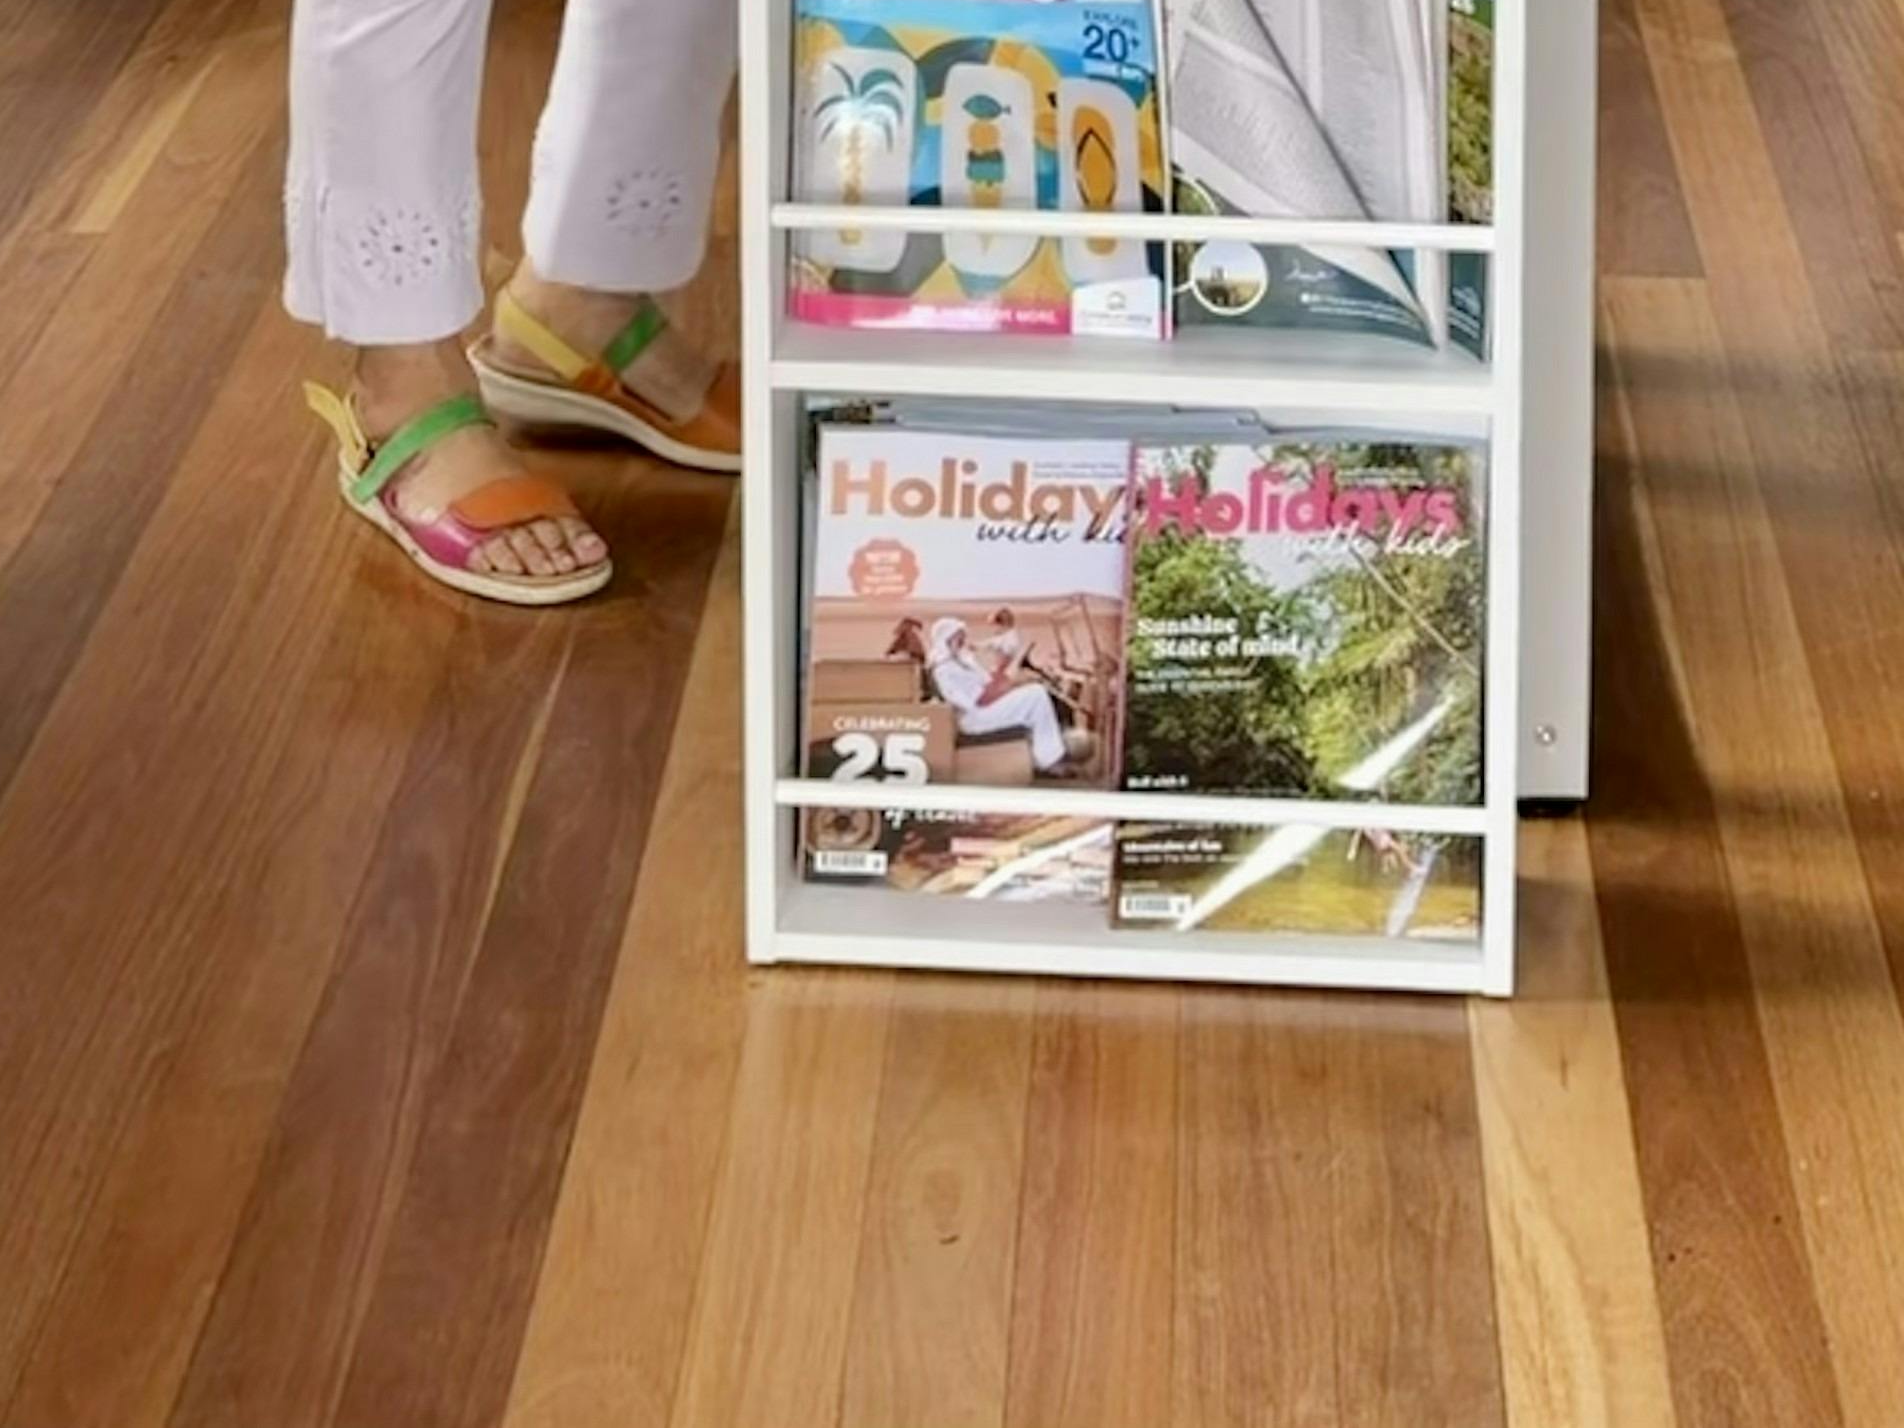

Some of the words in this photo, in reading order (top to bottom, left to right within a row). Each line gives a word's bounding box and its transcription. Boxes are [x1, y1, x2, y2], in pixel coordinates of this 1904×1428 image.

[1082, 24, 1140, 63] 20+
[829, 457, 1127, 524] Holiday
[1144, 461, 1460, 538] Holidays
[975, 511, 1070, 544] with
[1384, 518, 1471, 559] kids
[1137, 612, 1239, 636] Sunshine
[1150, 635, 1212, 659] State
[1215, 634, 1241, 657] of
[832, 715, 931, 734] CELEBRATING
[830, 734, 930, 786] 25
